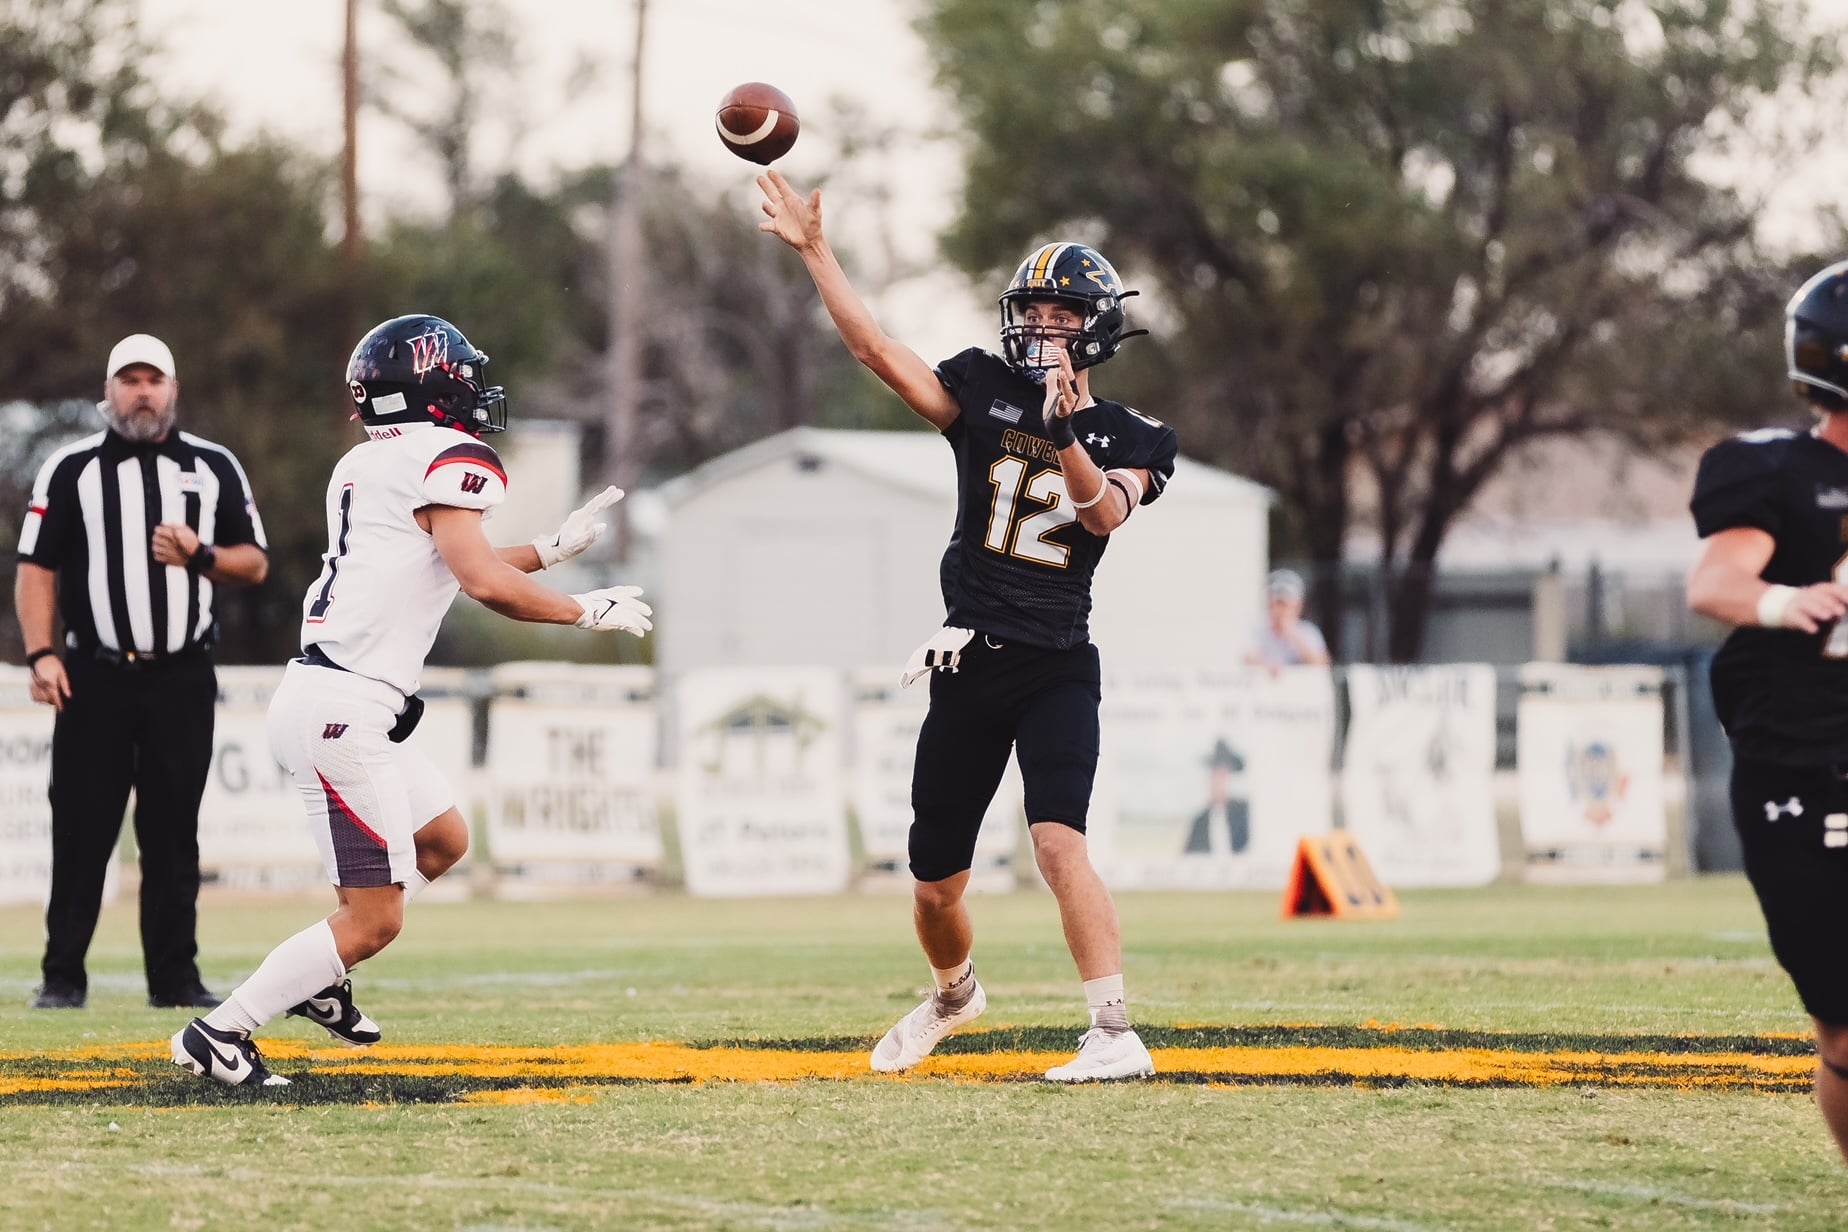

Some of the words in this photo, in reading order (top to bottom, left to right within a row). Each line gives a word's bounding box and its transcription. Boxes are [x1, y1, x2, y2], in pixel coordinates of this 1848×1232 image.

[460, 471, 488, 494] W
[984, 454, 1079, 569] 12
[306, 482, 354, 624] 1
[322, 723, 349, 741] W
